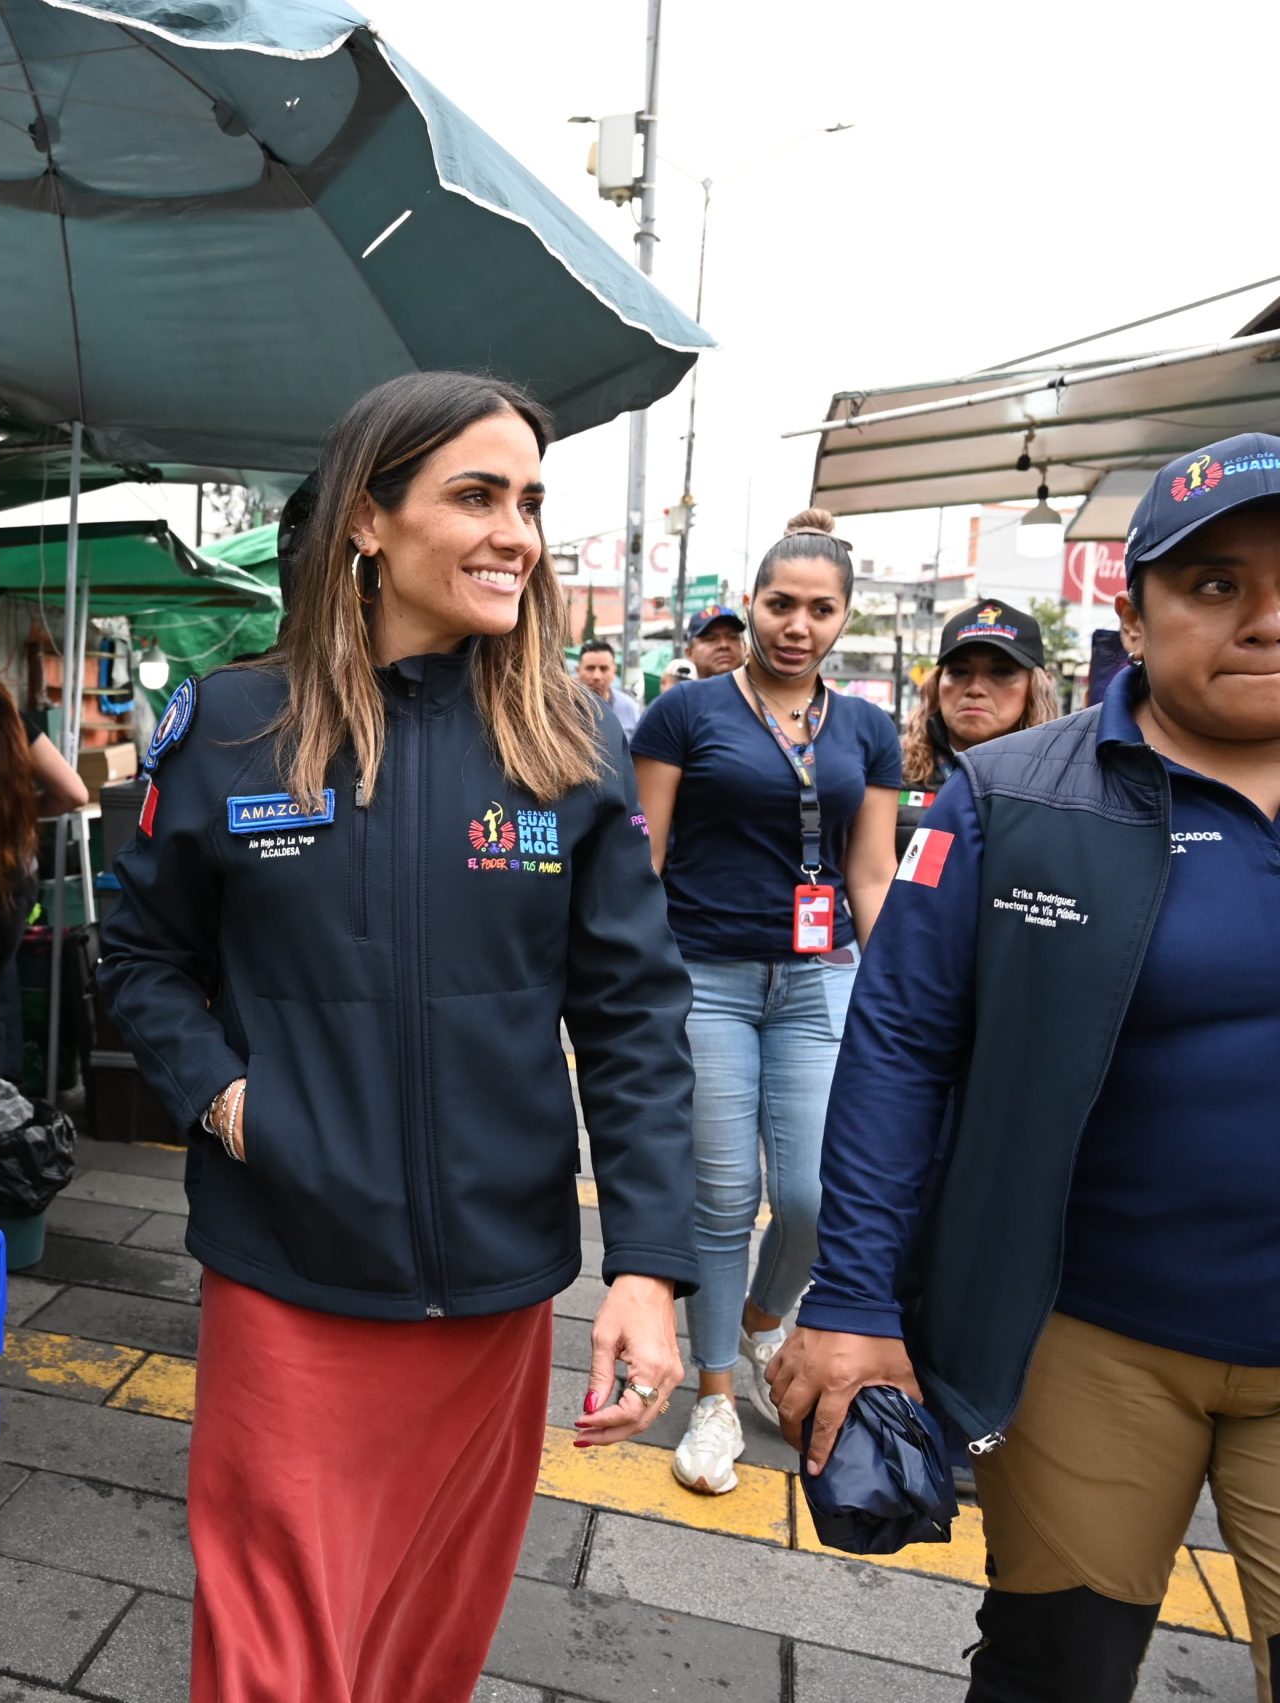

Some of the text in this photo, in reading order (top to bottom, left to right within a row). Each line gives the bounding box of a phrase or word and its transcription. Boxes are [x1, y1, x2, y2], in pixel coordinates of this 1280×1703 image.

[517, 810, 556, 818] ALCALDÍA
[517, 815, 557, 828] CUAU
[518, 825, 558, 843] HTE
[260, 838, 275, 849] Rojo
[276, 837, 286, 846] De
[298, 835, 316, 846] Vega
[519, 839, 559, 856] MOC
[260, 846, 301, 859] ALCALDESA
[467, 857, 479, 870] EL
[481, 857, 508, 871] PODER
[522, 860, 536, 872] TUS
[538, 861, 562, 874] MANOS
[1012, 887, 1033, 900] Erika
[993, 898, 1029, 912] Directora
[1030, 904, 1039, 914] de
[1081, 913, 1088, 925] y
[1024, 912, 1057, 928] Mercados
